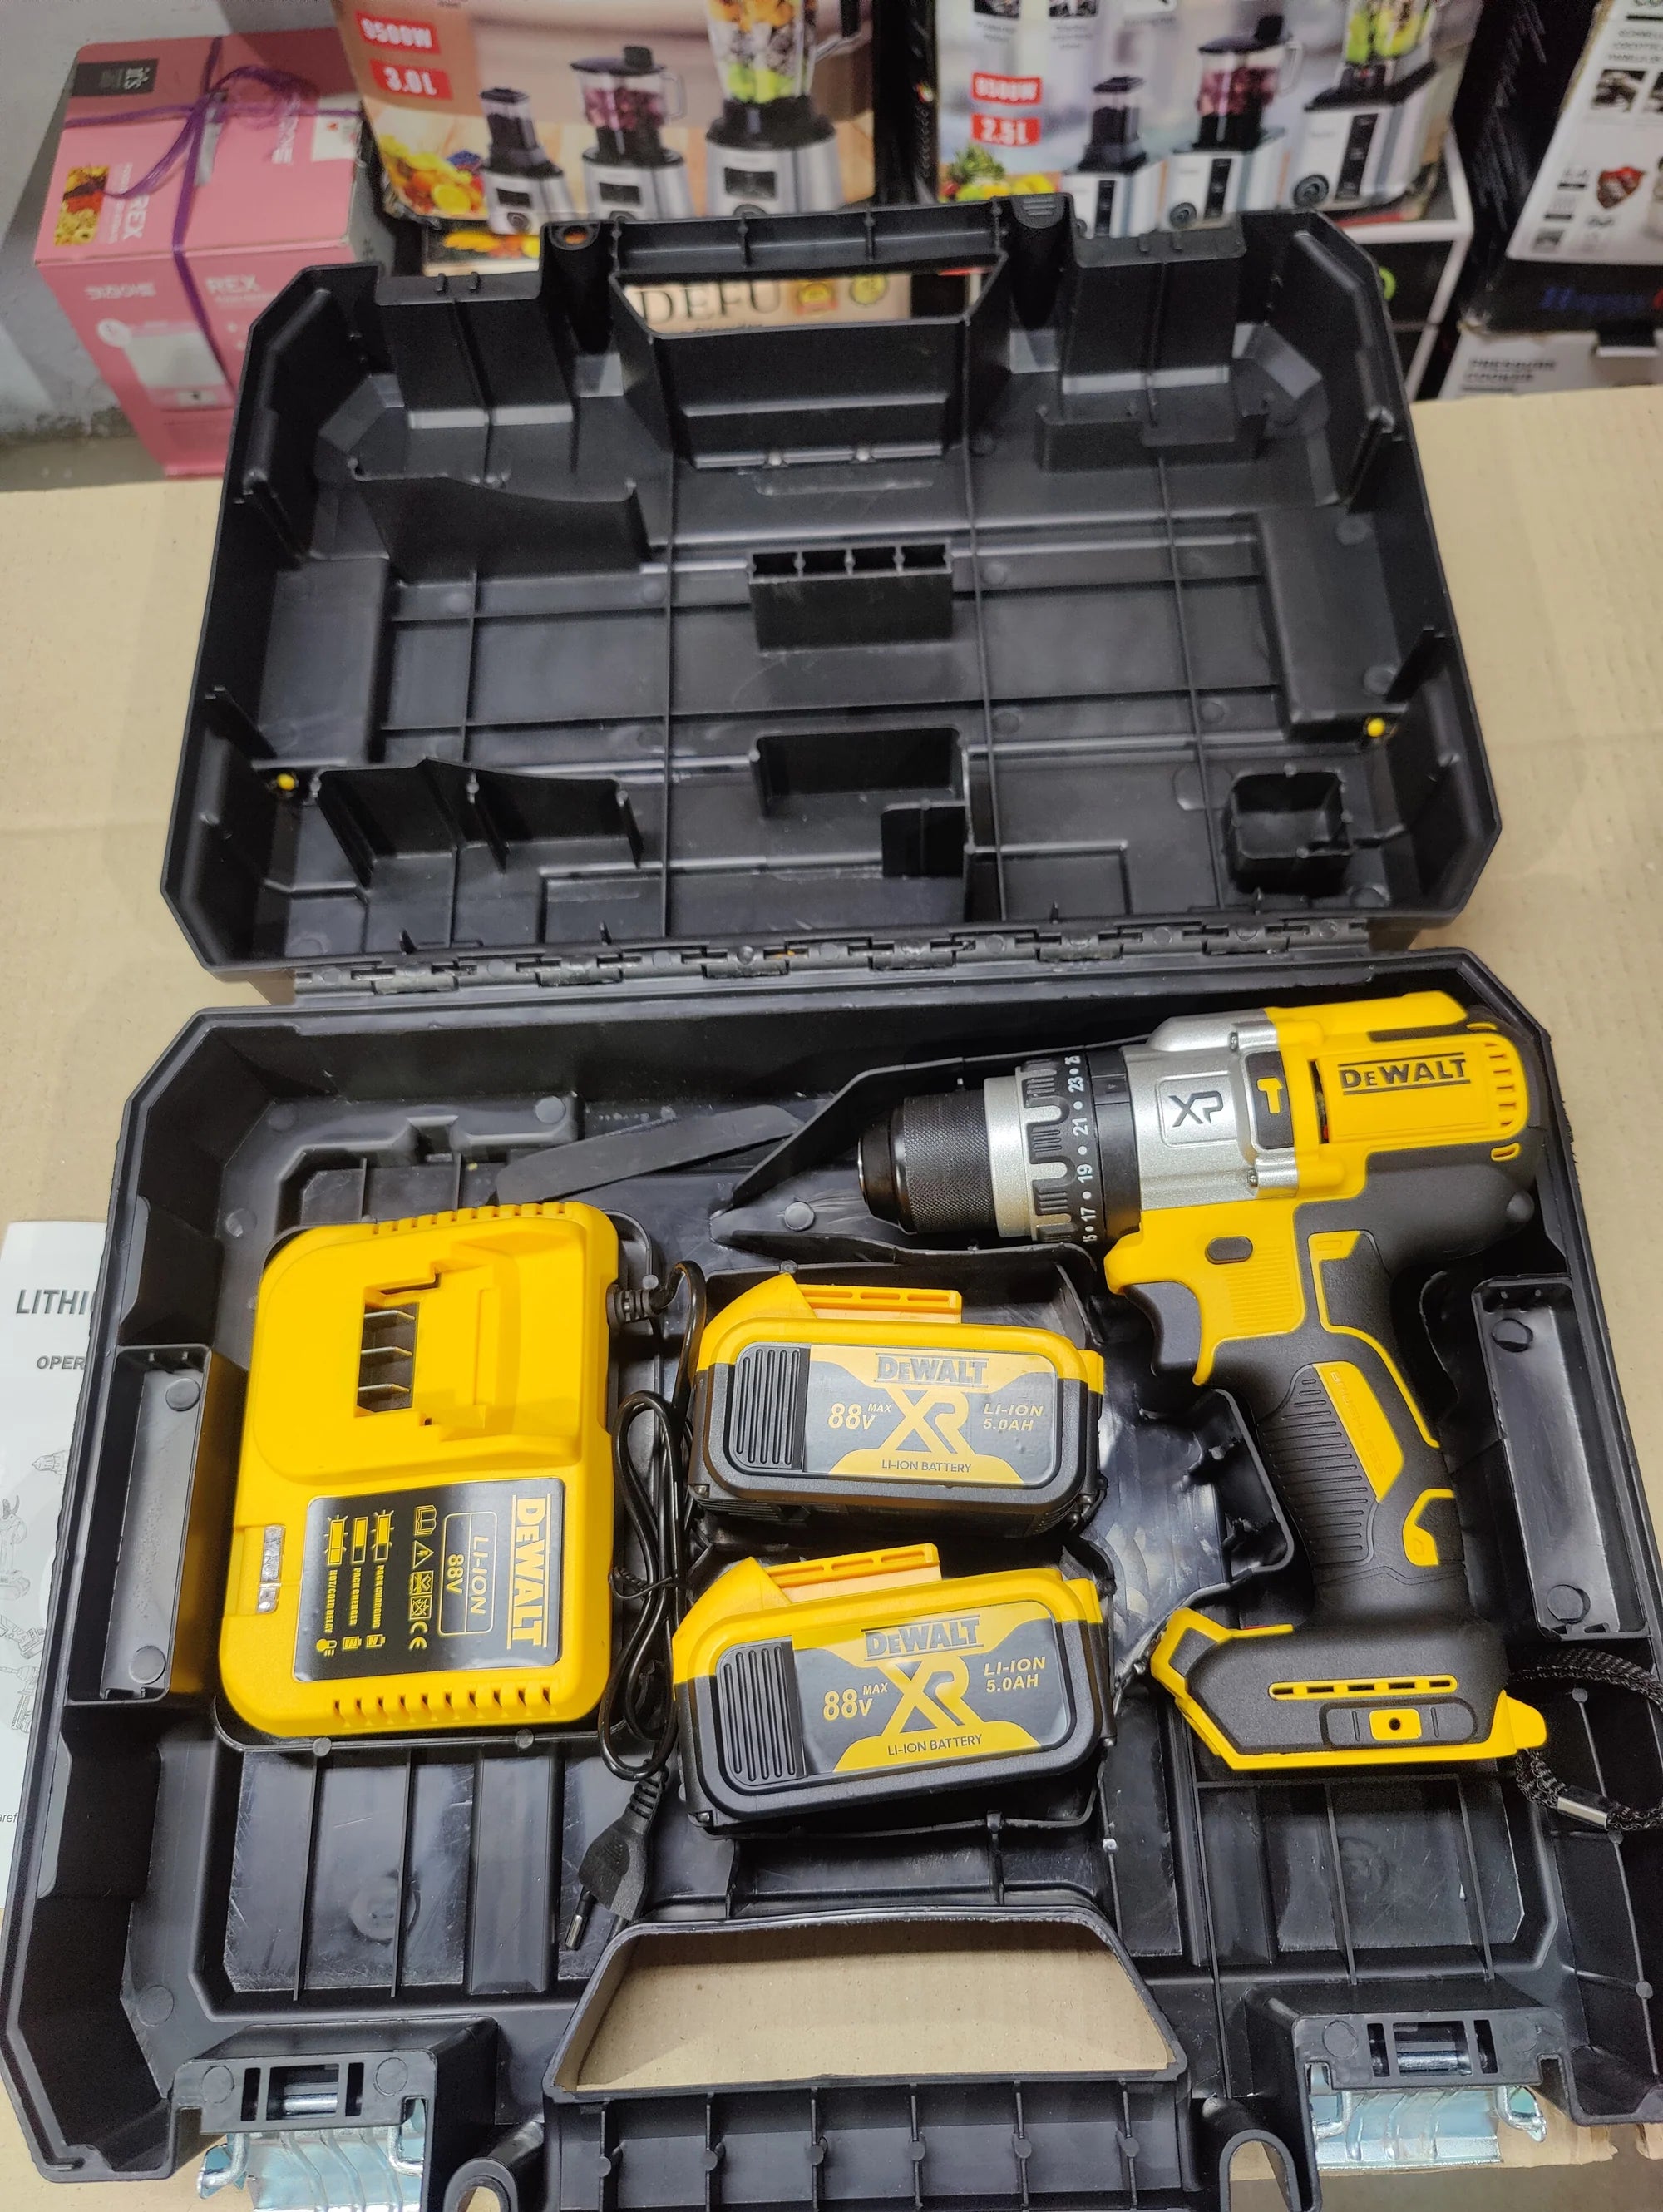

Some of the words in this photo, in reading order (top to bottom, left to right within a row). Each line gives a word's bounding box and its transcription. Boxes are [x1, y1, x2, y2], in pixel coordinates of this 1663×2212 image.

[383, 67, 437, 96] 3.0L
[982, 117, 1029, 146] 2.5L
[122, 194, 150, 240] REX
[205, 275, 261, 293] REX
[1340, 1057, 1468, 1089] DEWALT
[1068, 1076, 1084, 1094] 23
[1168, 1089, 1224, 1128] XP
[1072, 1118, 1089, 1136] 21
[1076, 1163, 1093, 1184] 19
[1081, 1207, 1097, 1222] 17
[16, 1289, 96, 1315] LITHI
[37, 1355, 86, 1370] OPER
[877, 1355, 989, 1385] DEWALT
[867, 1403, 892, 1413] MAX
[983, 1402, 1044, 1417] LI-ION
[879, 1387, 976, 1454] XR
[983, 1418, 1034, 1431] 5.0AH
[881, 1459, 919, 1471] LI-ION
[921, 1461, 972, 1473] BATTERY
[352, 1567, 362, 1589] PACK
[376, 1564, 386, 1587] PACK
[446, 1553, 465, 1595] 88V
[471, 1536, 490, 1615] LI-ION
[511, 1497, 547, 1647] DEWALT
[326, 1569, 338, 1609] HOT/COLD
[372, 1587, 383, 1629] CHARGING
[323, 1610, 334, 1634] DELAY
[865, 1618, 980, 1657] DEWALT
[984, 1656, 1046, 1676] LI-ION
[862, 1682, 888, 1696] MAX
[985, 1674, 1039, 1693] 5.0AH
[881, 1659, 984, 1736] XR
[887, 1740, 926, 1756] LI-ION
[930, 1733, 983, 1750] BATTERY
